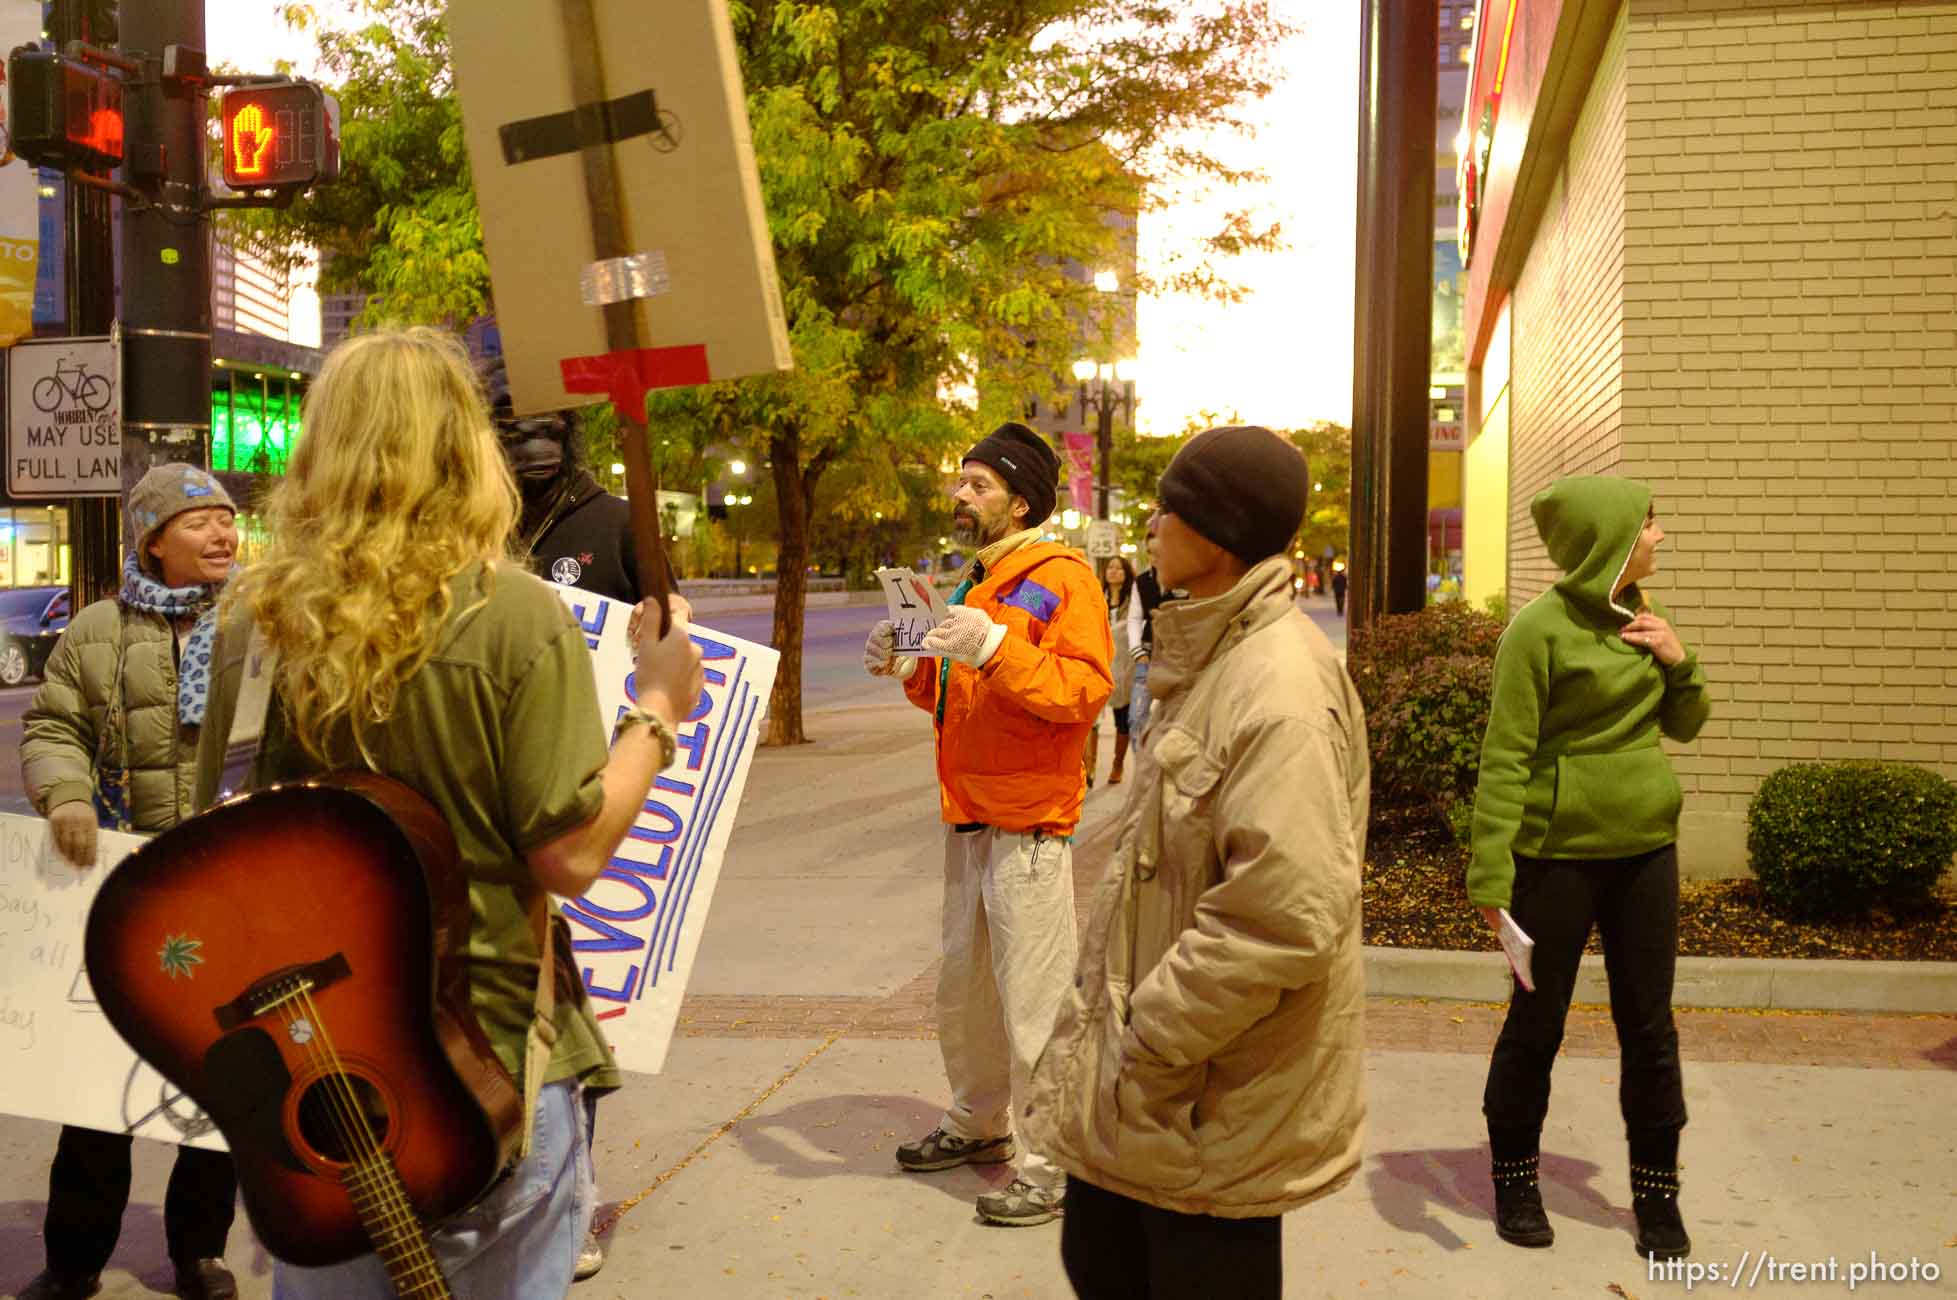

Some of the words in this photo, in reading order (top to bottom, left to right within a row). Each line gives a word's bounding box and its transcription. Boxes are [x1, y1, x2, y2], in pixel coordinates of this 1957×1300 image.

[27, 426, 67, 446] MAY
[80, 425, 119, 446] USE
[17, 458, 66, 478] FULL
[77, 458, 118, 478] LAN
[1091, 539, 1112, 553] 25
[892, 578, 916, 608] I
